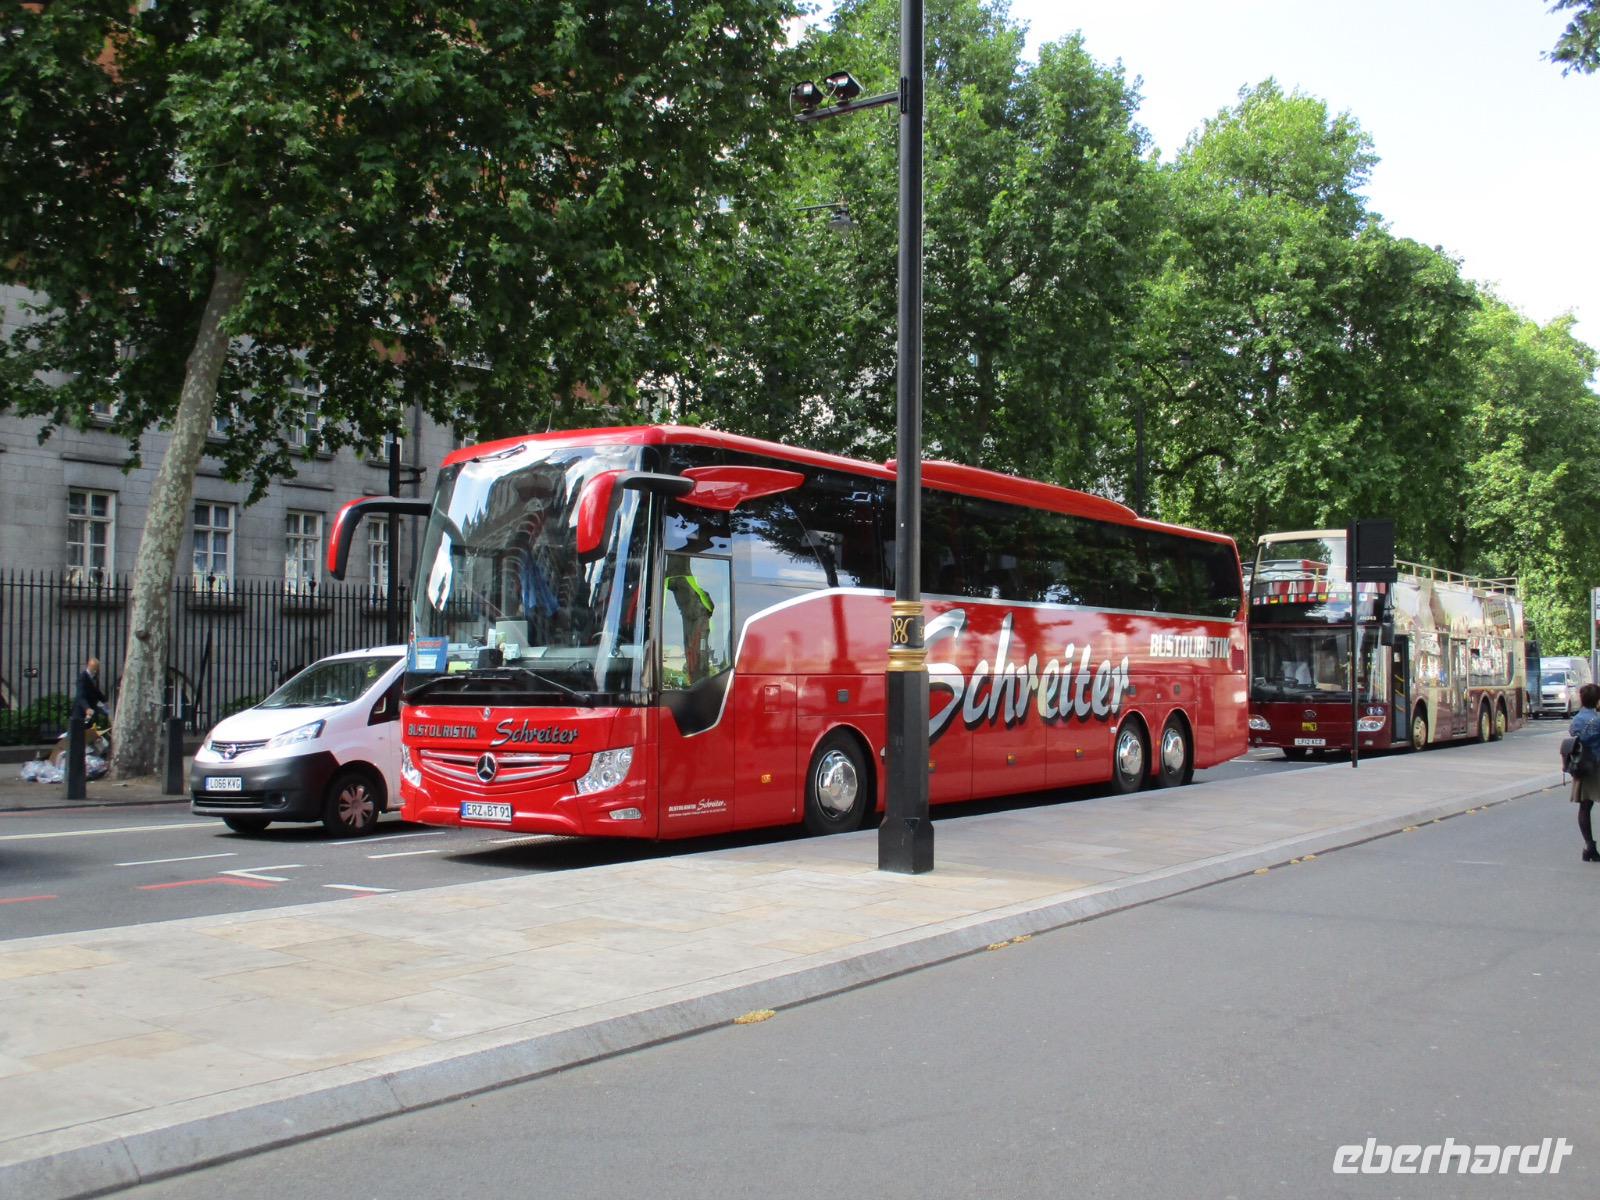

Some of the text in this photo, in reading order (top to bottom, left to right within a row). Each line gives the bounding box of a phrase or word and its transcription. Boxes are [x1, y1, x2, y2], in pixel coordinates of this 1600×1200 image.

[1149, 633, 1231, 659] BUSTOURISTIK
[490, 718, 579, 746] Schreiter
[466, 804, 511, 818] ERZ BT 91
